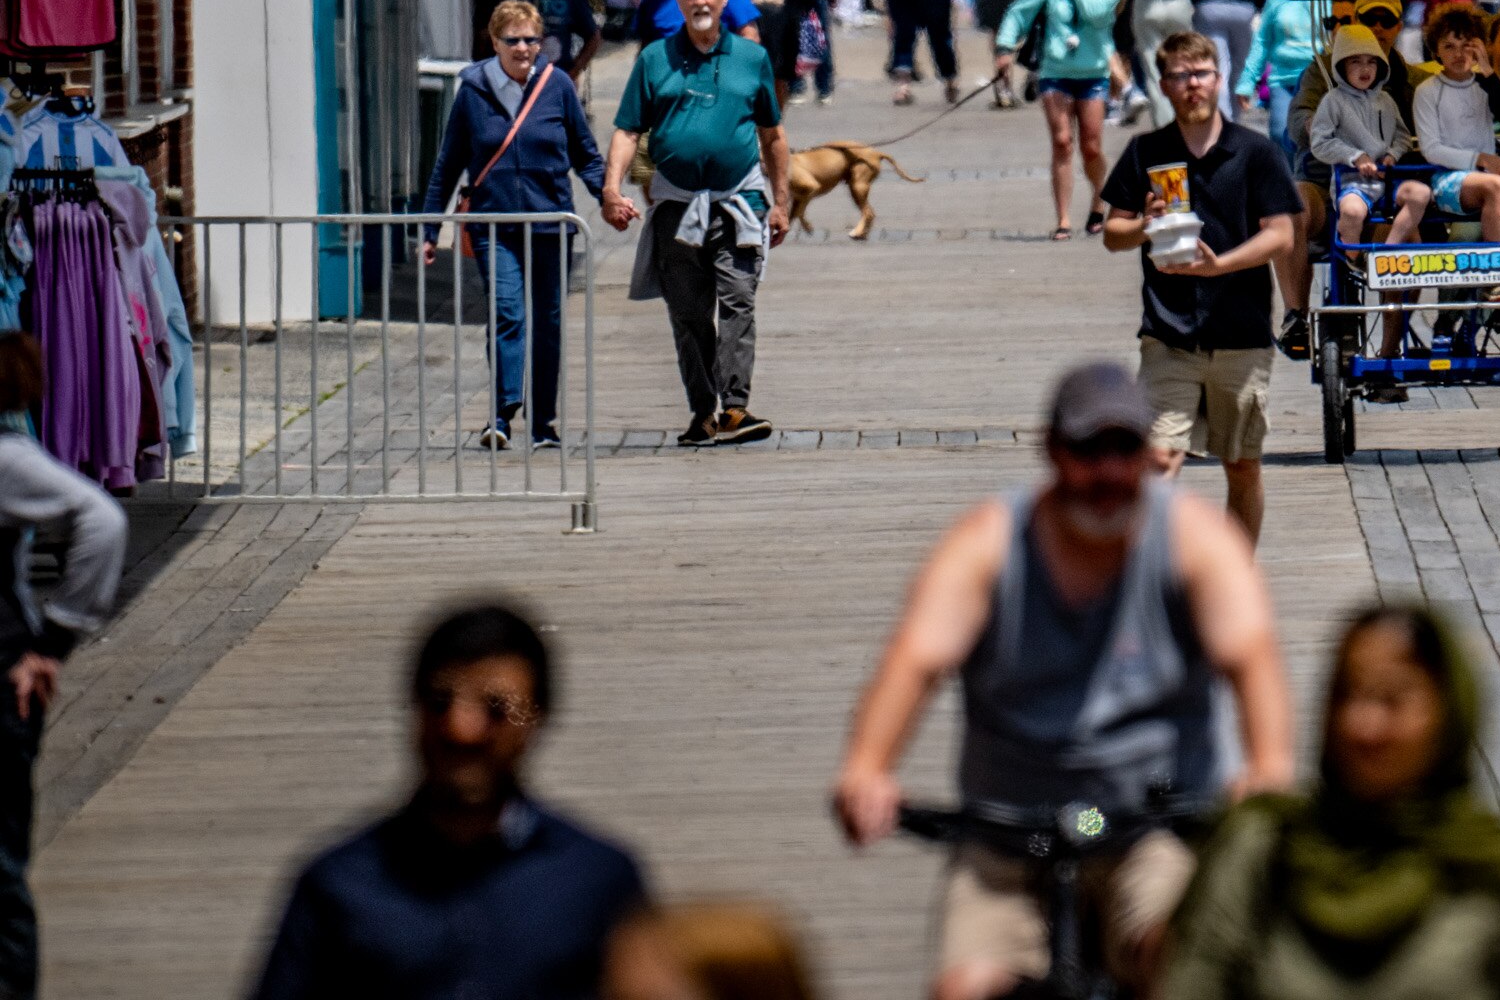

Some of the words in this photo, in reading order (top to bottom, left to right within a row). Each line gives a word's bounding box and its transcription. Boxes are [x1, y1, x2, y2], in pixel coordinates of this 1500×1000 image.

[1375, 255, 1411, 277] BIG
[1411, 253, 1457, 275] JIM'S
[1424, 275, 1455, 285] STREET
